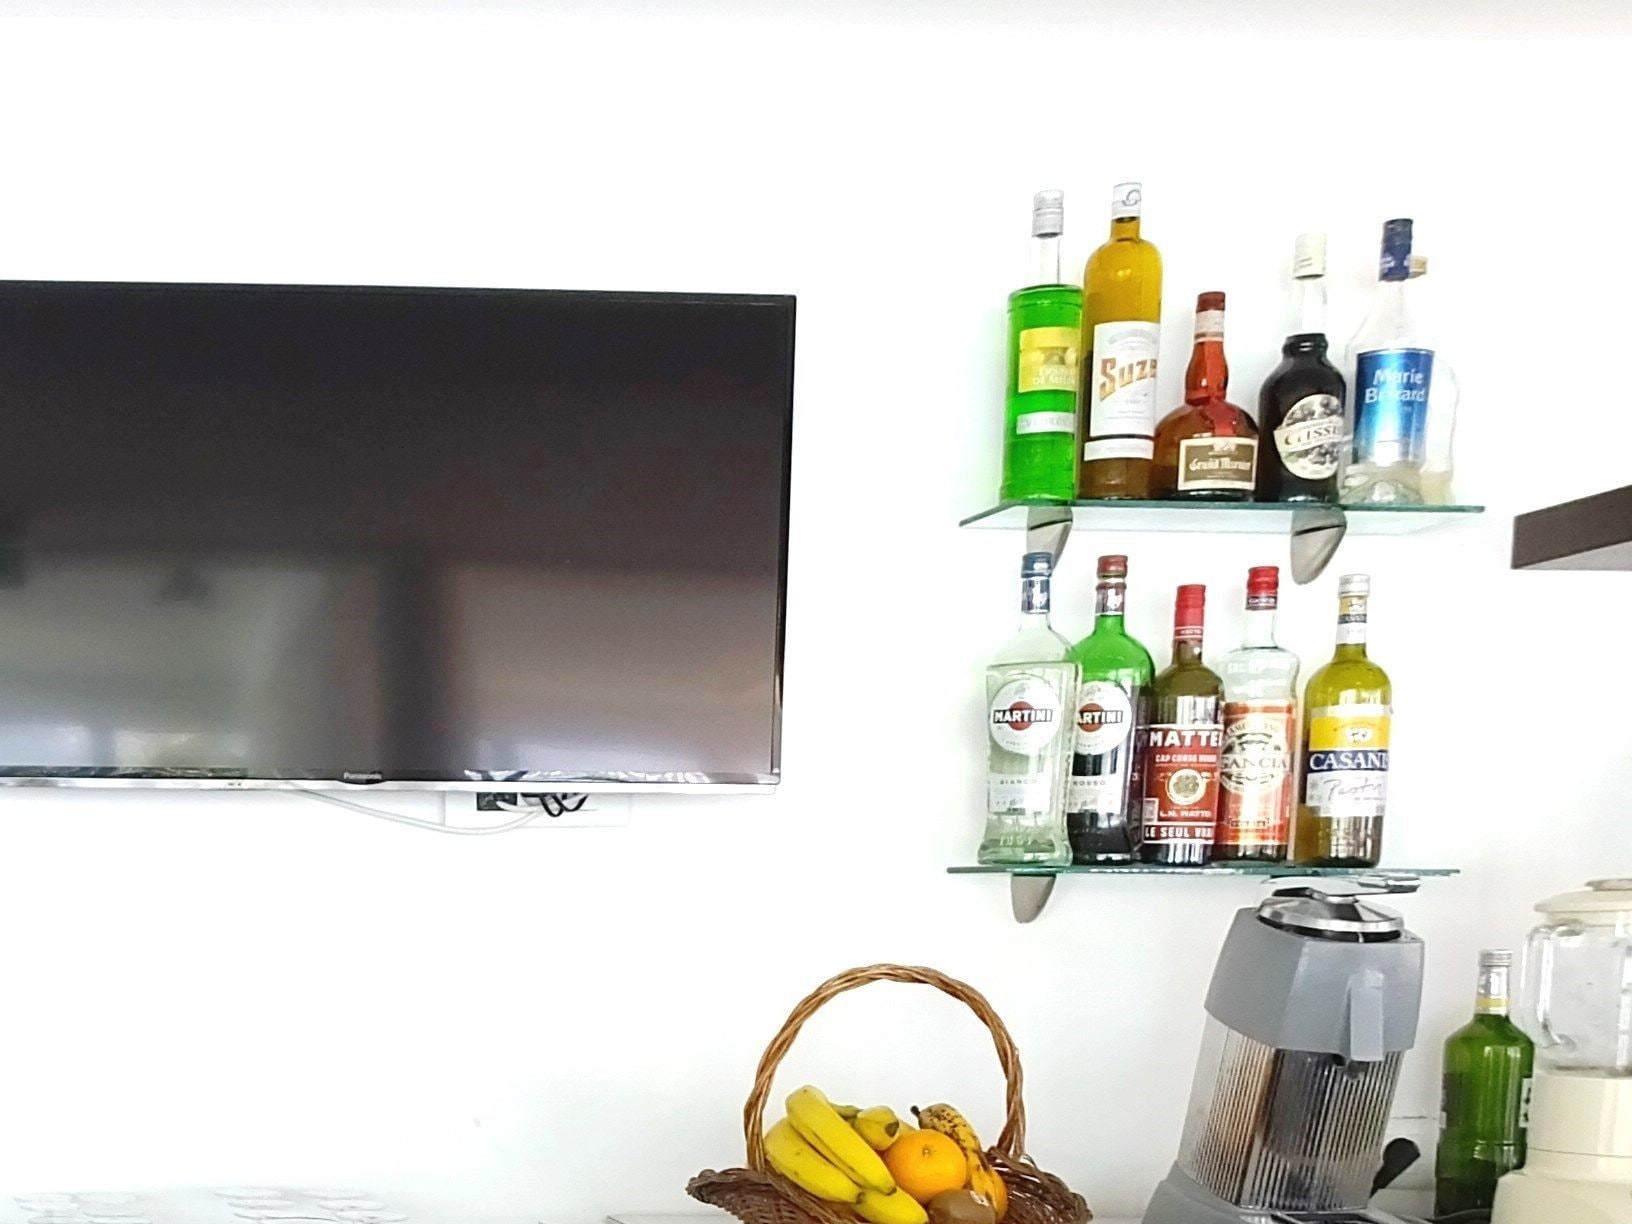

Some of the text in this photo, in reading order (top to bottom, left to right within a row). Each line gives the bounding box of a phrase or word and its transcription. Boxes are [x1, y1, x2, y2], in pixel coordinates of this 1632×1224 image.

[1099, 357, 1158, 402] Suze
[993, 708, 1053, 724] MARTINI
[1076, 710, 1123, 725] ARTINI
